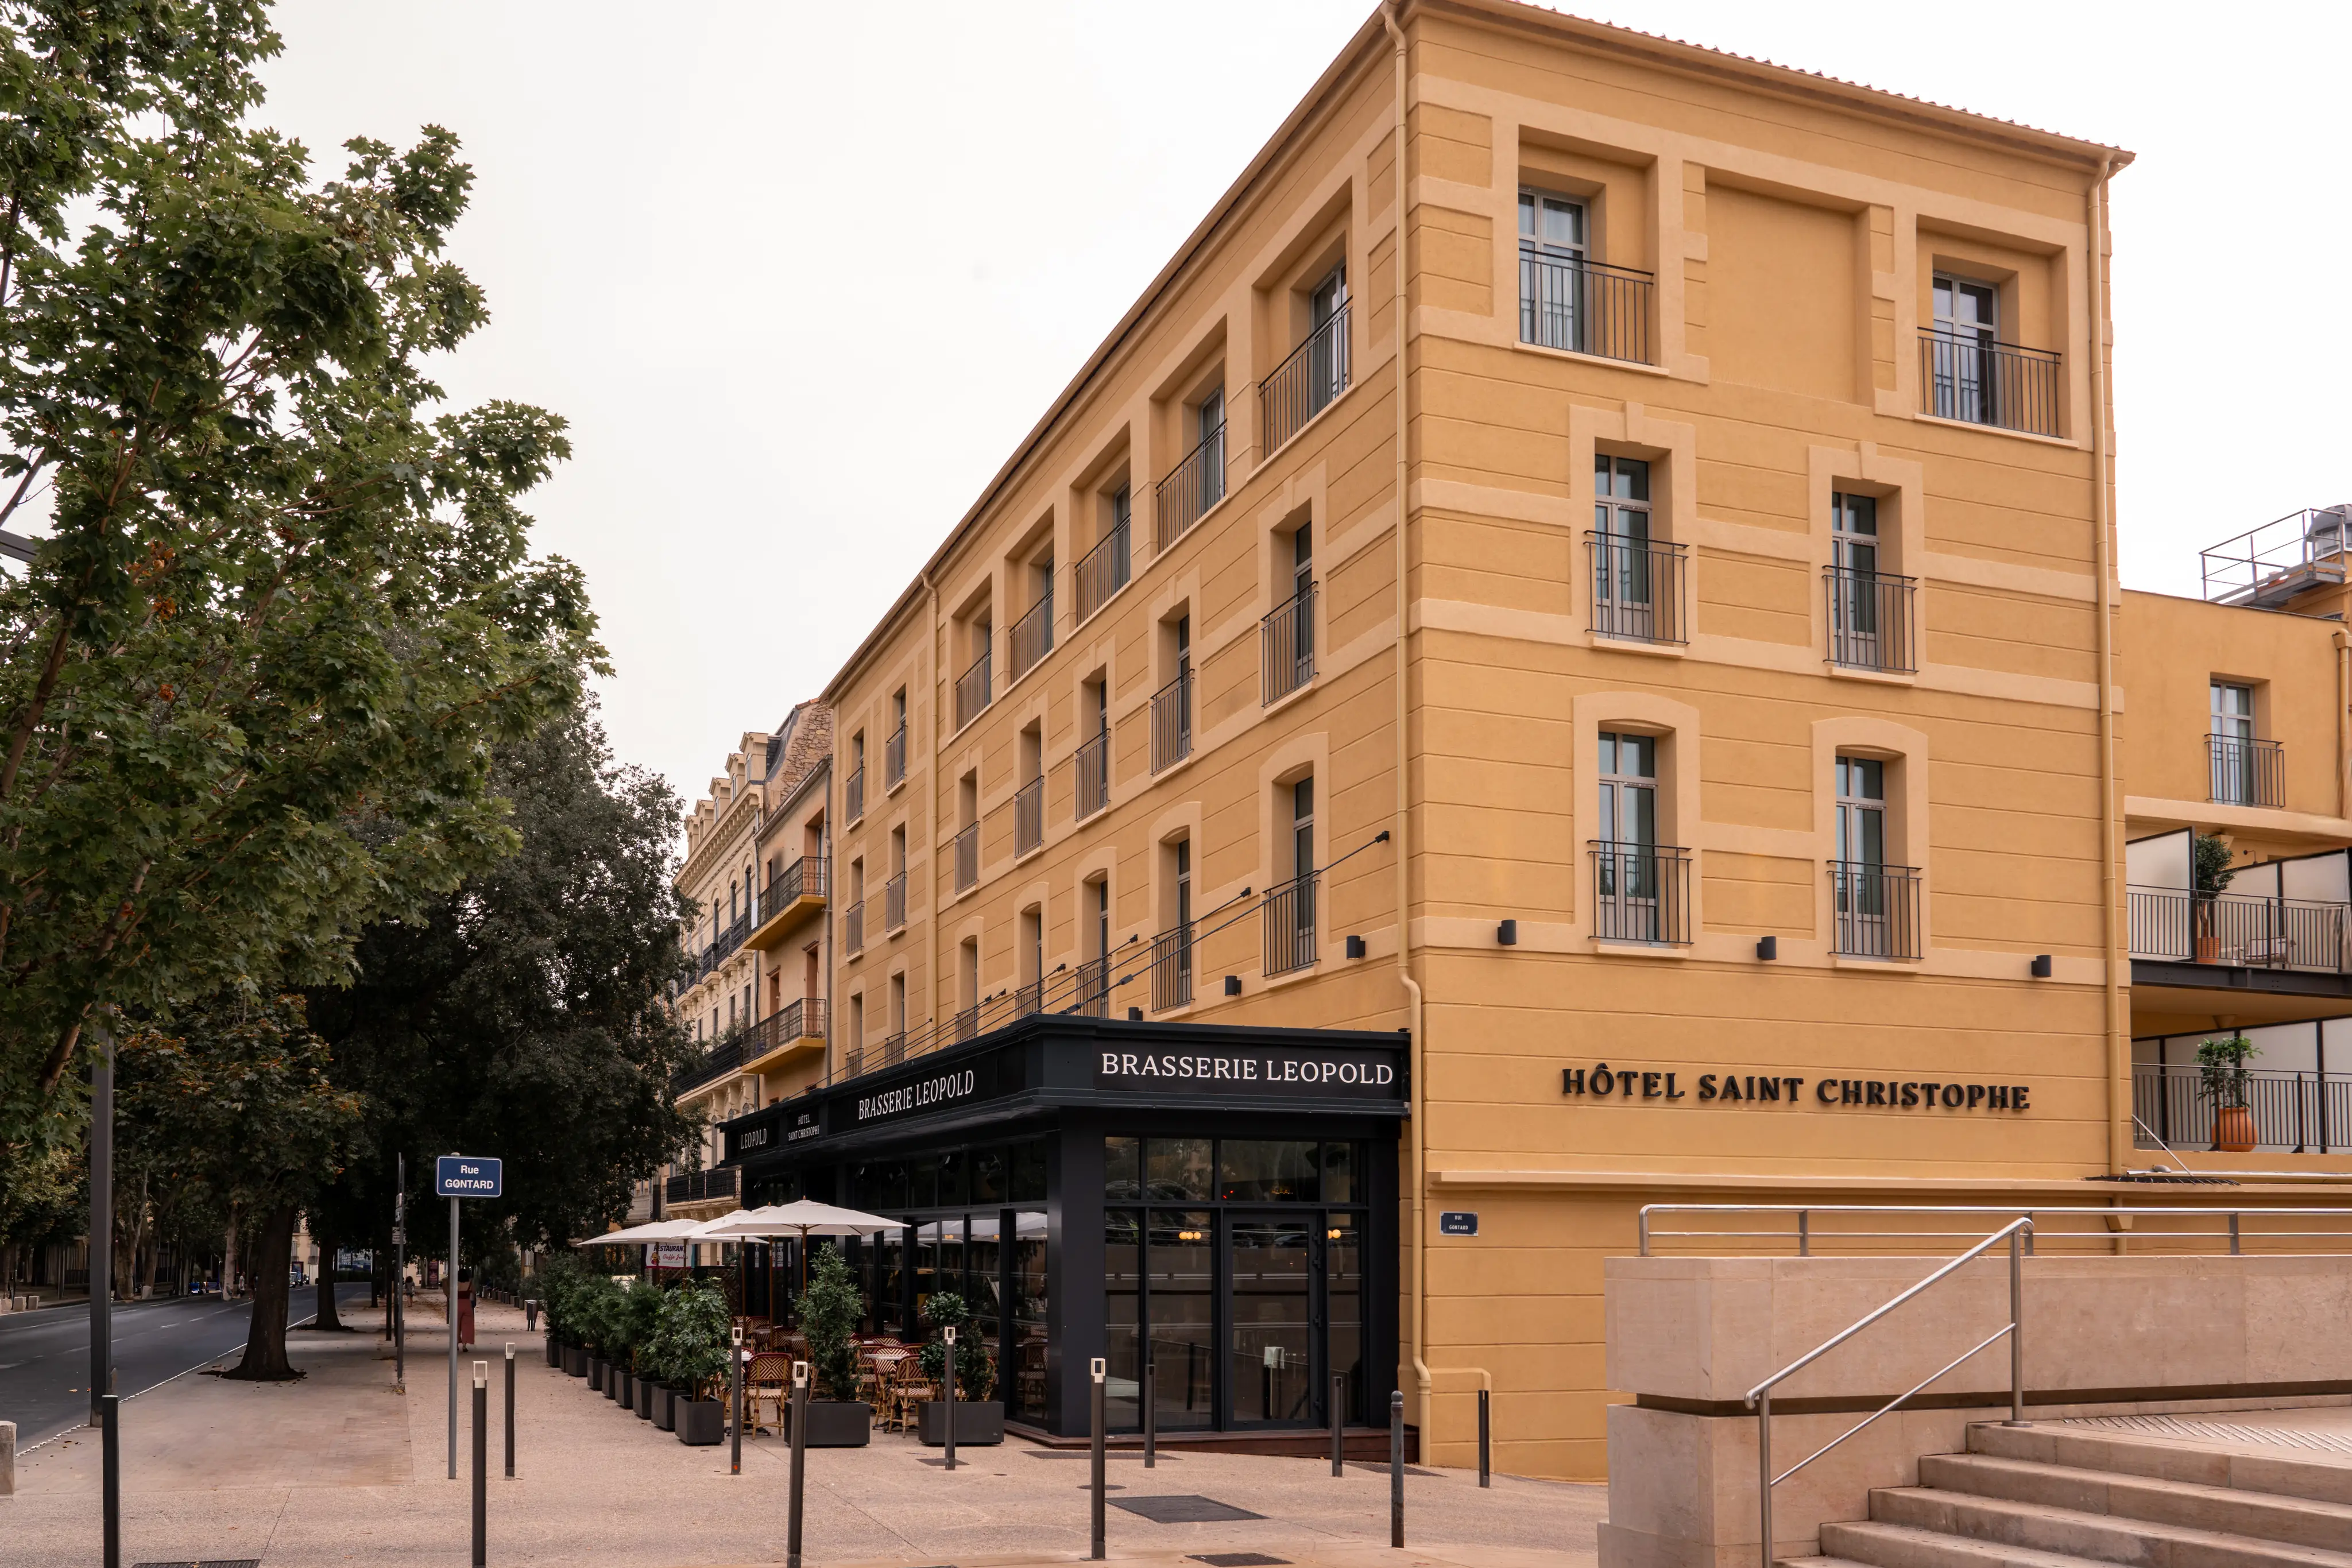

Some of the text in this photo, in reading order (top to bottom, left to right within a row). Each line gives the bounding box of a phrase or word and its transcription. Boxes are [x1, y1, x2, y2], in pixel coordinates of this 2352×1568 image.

[1102, 1053, 1394, 1085] BRASSERIE LEOPOLD
[1562, 1063, 2031, 1110] HÔTEL SAINT CHRISTOPHE
[858, 1070, 974, 1120] BRASSERIE LEOPOLD
[798, 1114, 810, 1125] HÔTEL
[741, 1128, 767, 1149] LEOPOLD
[788, 1130, 798, 1141] SAINT
[461, 1165, 479, 1174] Rue
[445, 1179, 494, 1189] GONTARD
